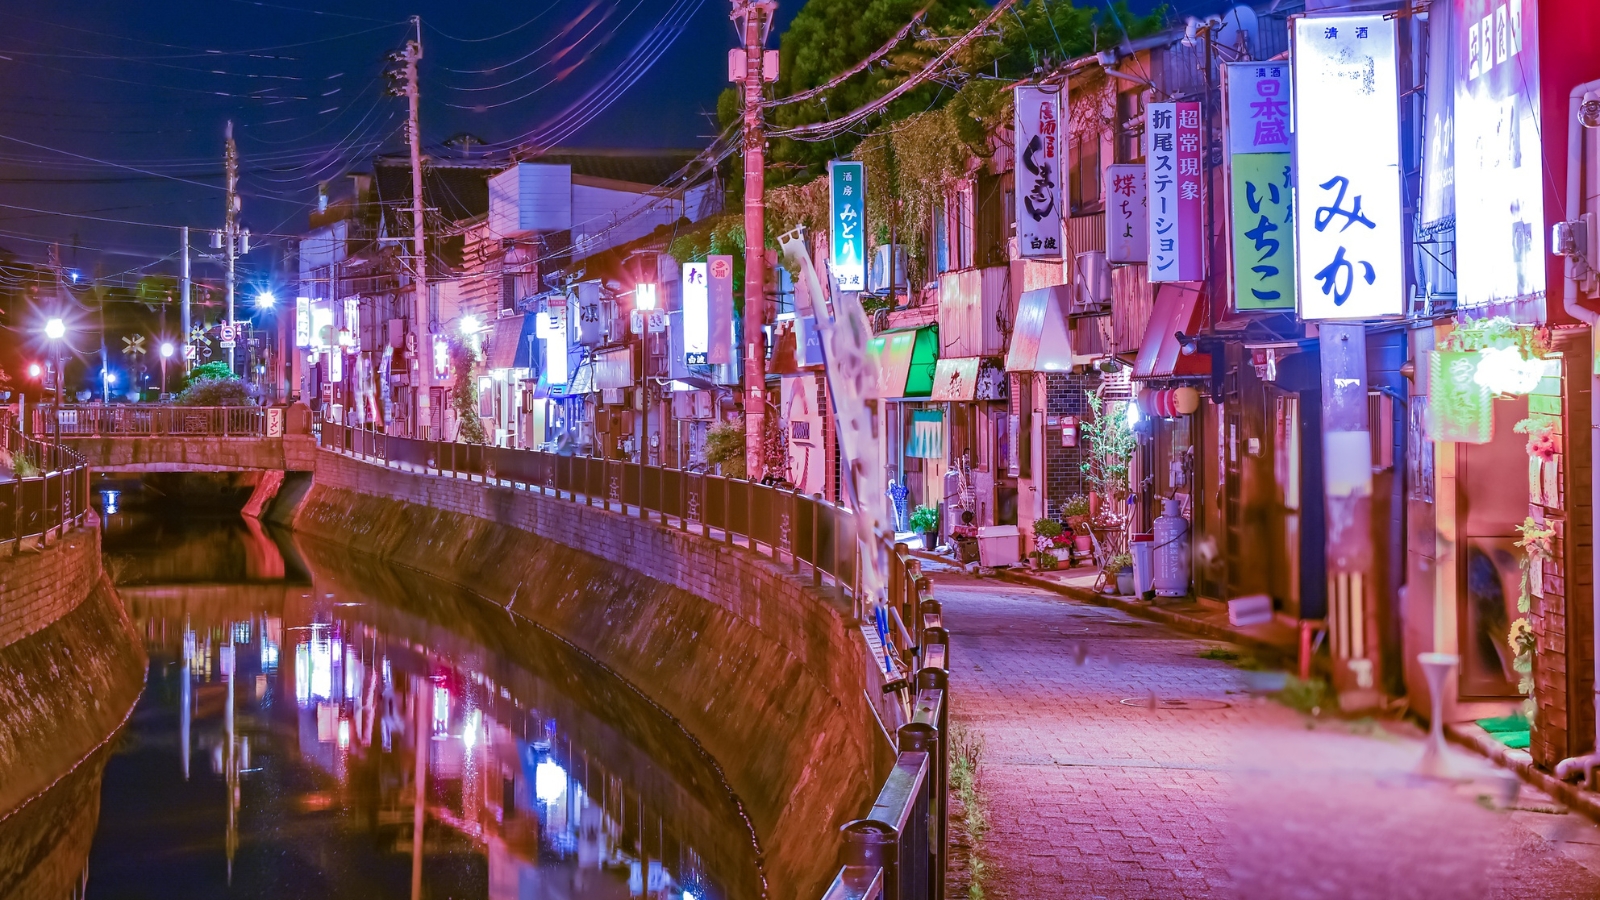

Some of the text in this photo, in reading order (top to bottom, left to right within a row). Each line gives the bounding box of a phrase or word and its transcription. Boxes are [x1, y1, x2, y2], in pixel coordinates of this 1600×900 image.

[1324, 27, 1368, 39] 清酒
[1470, 11, 1521, 70] 立ち食い
[1256, 67, 1280, 77] 清酒
[1250, 79, 1290, 146] 日本盛
[843, 172, 853, 196] 酒房
[1179, 110, 1199, 200] 超常現象
[1152, 110, 1174, 271] 折尾ステーション
[840, 203, 857, 262] みどり
[1031, 237, 1057, 250] 白波
[1244, 181, 1281, 300] いちこ
[1314, 175, 1376, 306] みか
[270, 410, 278, 435] ラーメン
